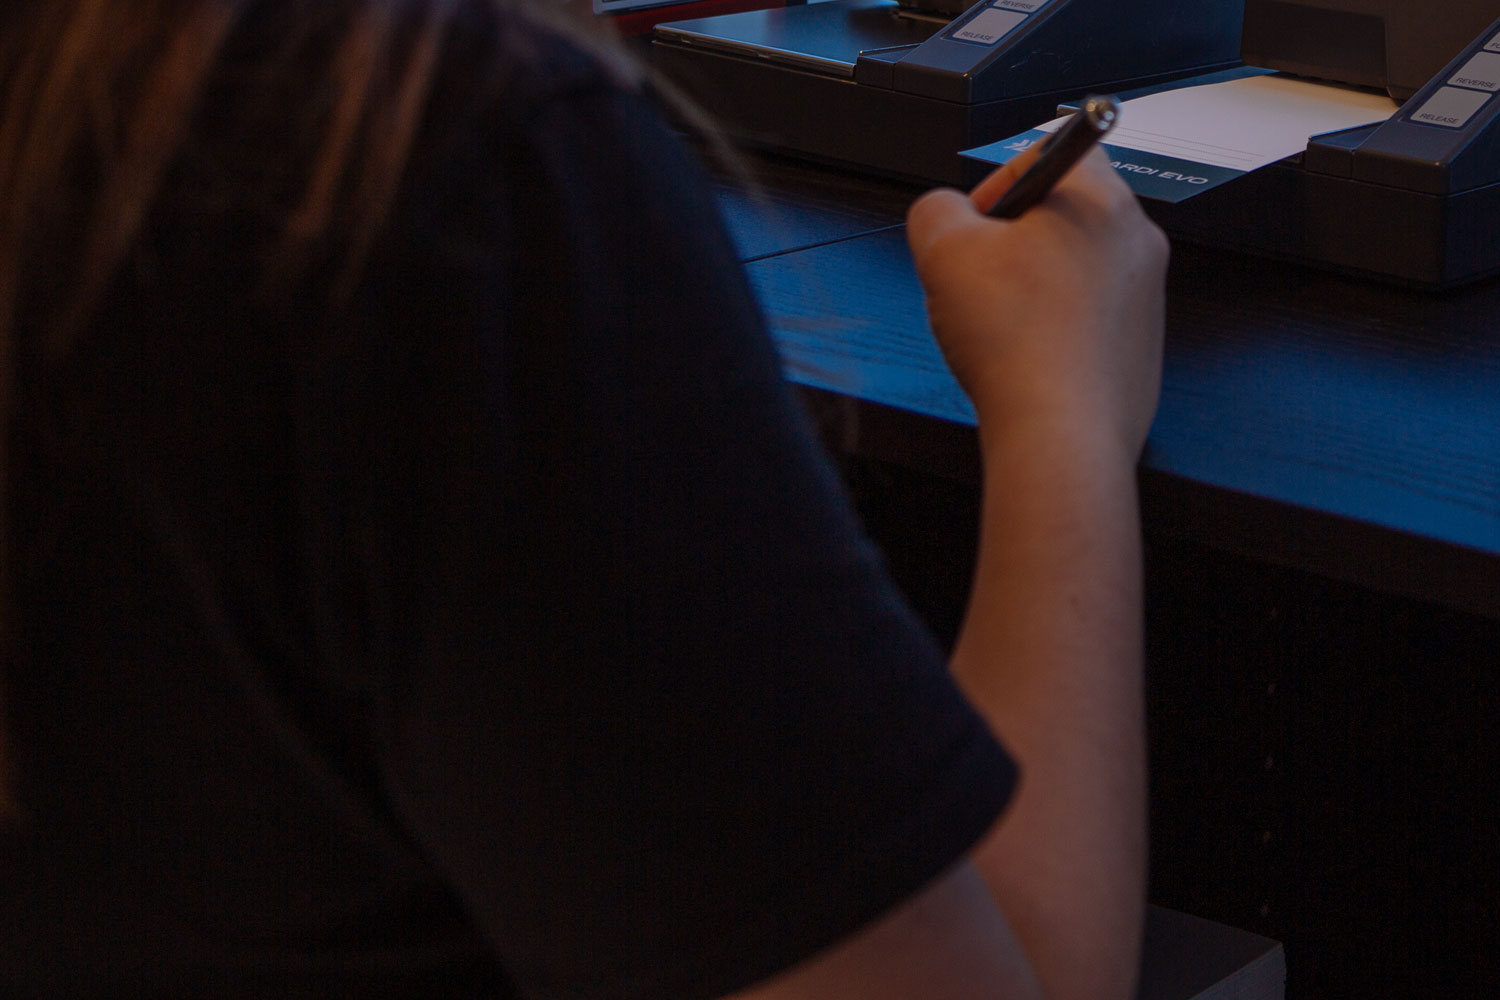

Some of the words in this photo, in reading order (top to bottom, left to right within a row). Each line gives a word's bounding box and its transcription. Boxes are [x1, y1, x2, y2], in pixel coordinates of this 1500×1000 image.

[1001, 0, 1037, 11] REVERSE
[962, 30, 994, 42] RELEASE
[1456, 77, 1497, 89] REVERSE
[1419, 113, 1459, 125] RELEASE
[1109, 160, 1160, 176] ARDI
[1157, 170, 1209, 185] EVO
